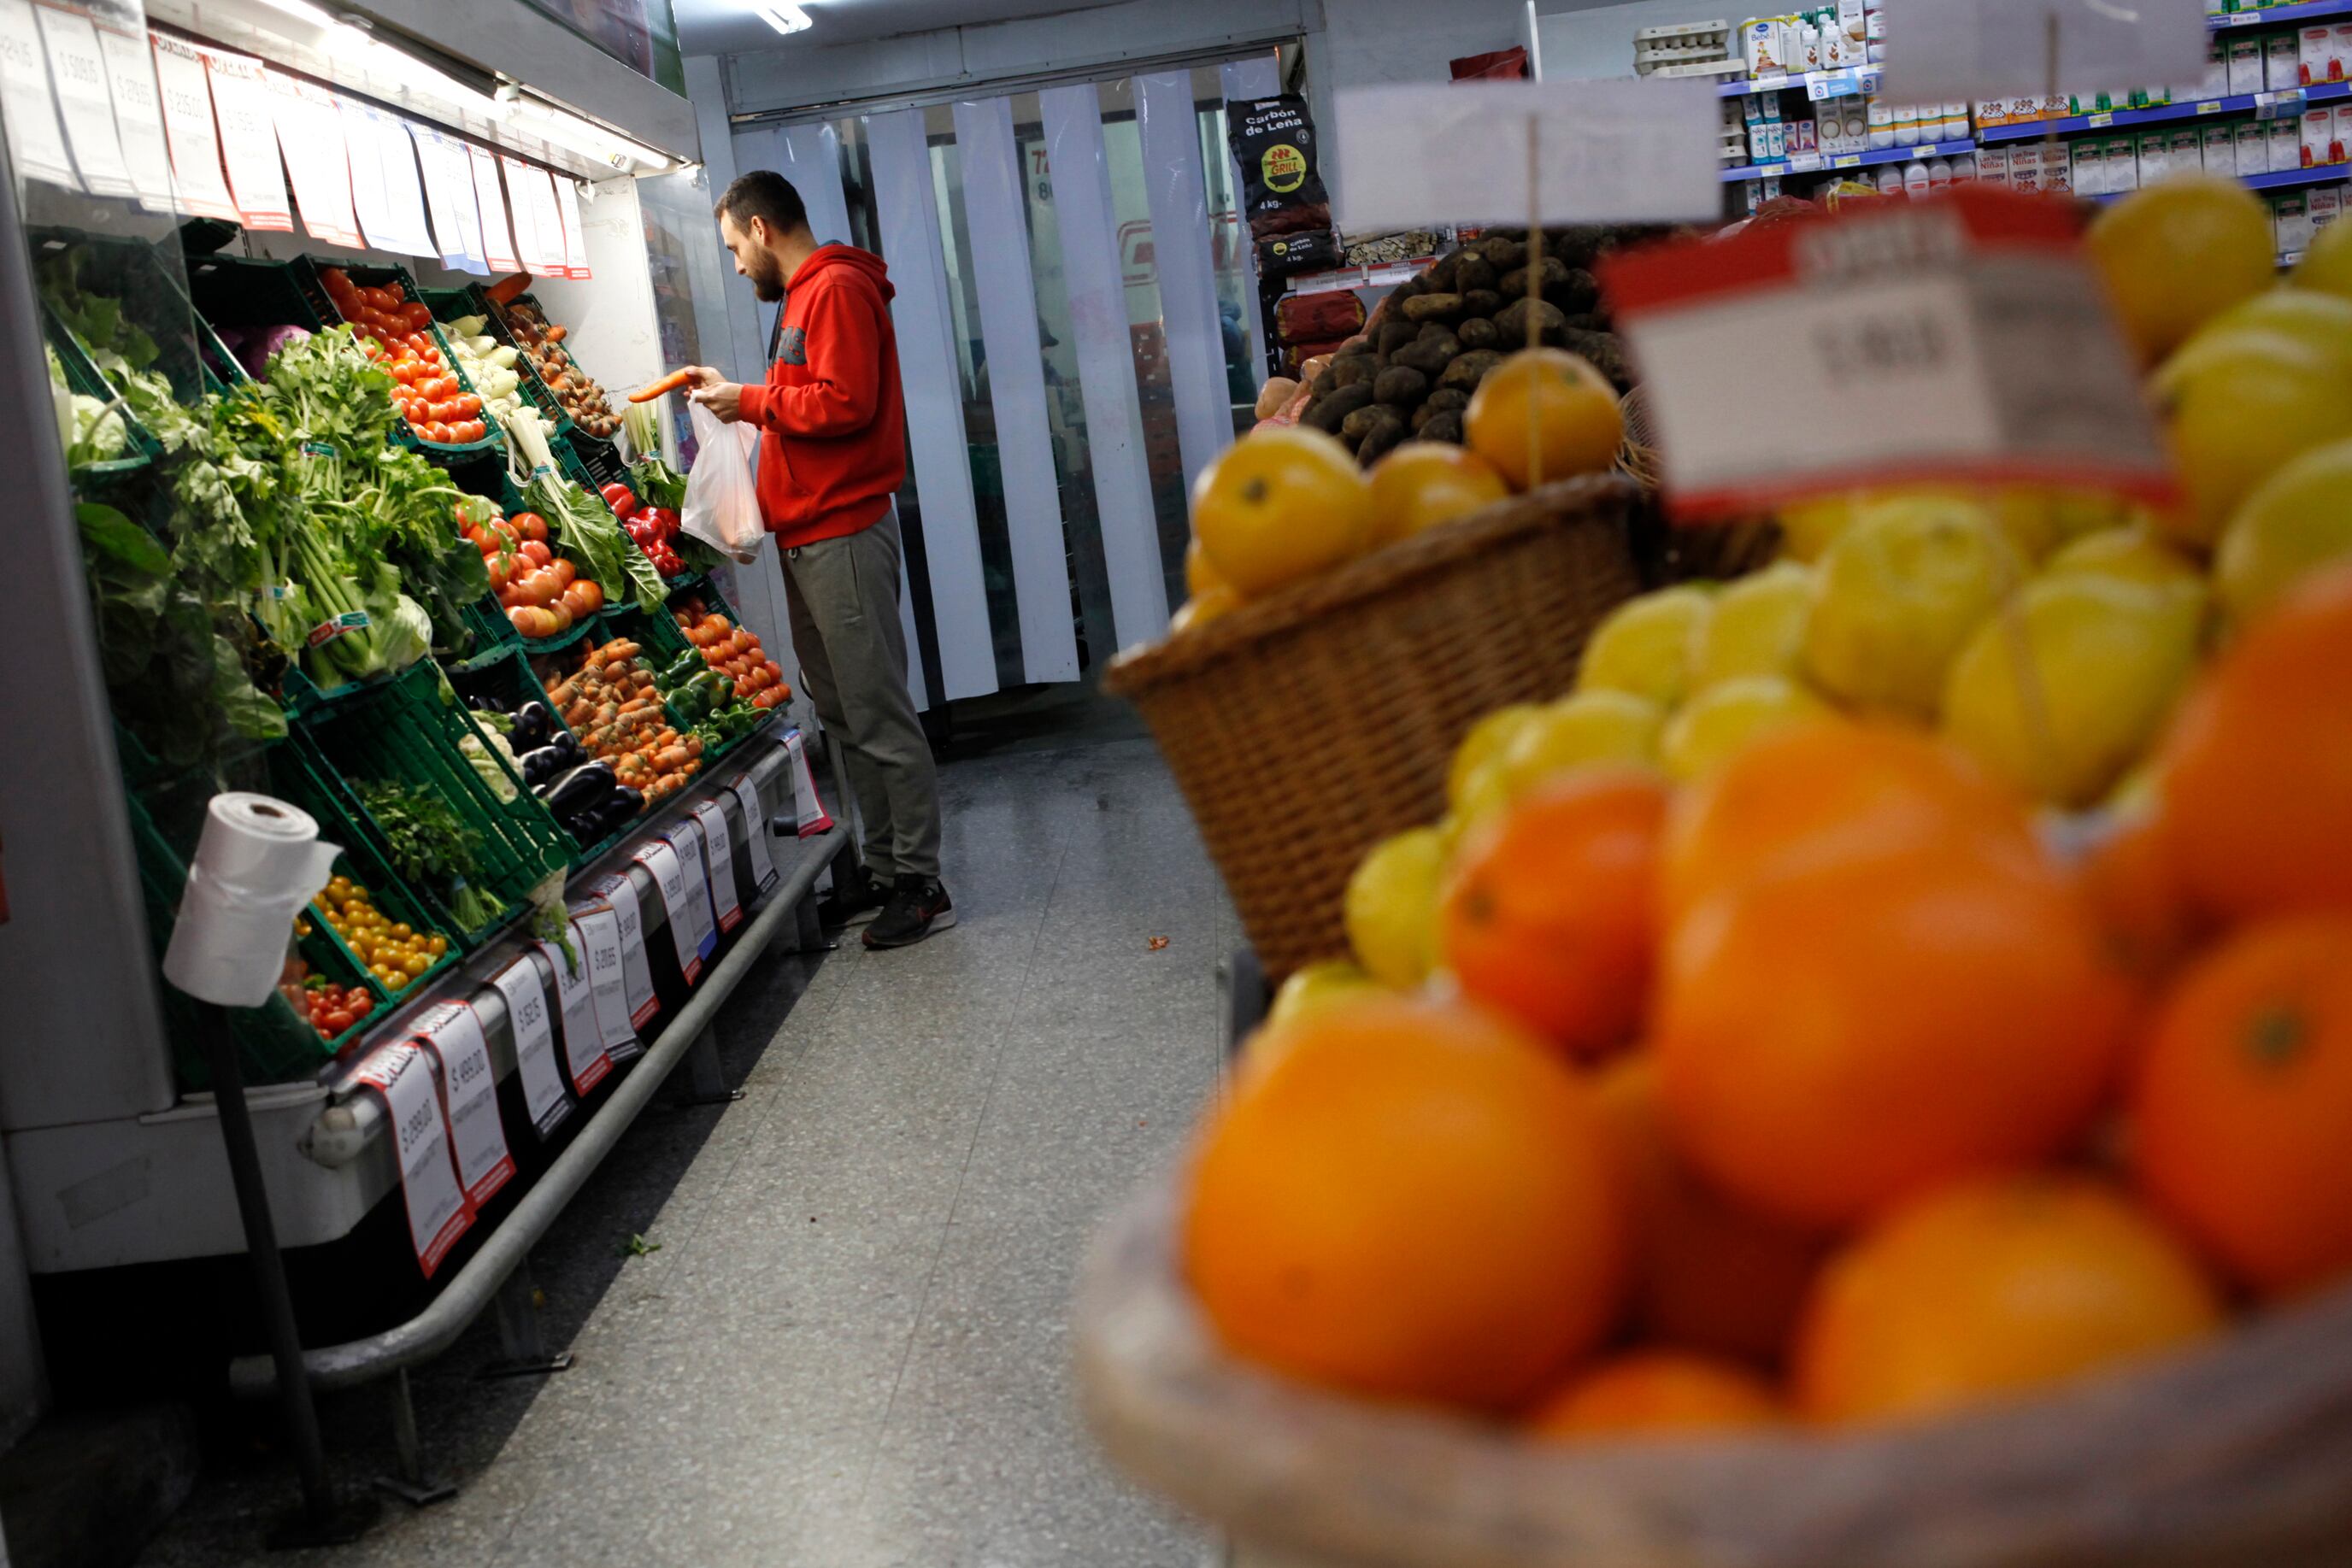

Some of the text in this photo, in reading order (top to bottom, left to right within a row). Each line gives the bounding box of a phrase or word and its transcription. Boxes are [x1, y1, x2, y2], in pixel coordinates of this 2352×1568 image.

[1245, 109, 1297, 126] Carbón
[1245, 117, 1303, 137] de Leña
[1271, 161, 1299, 177] GRILL
